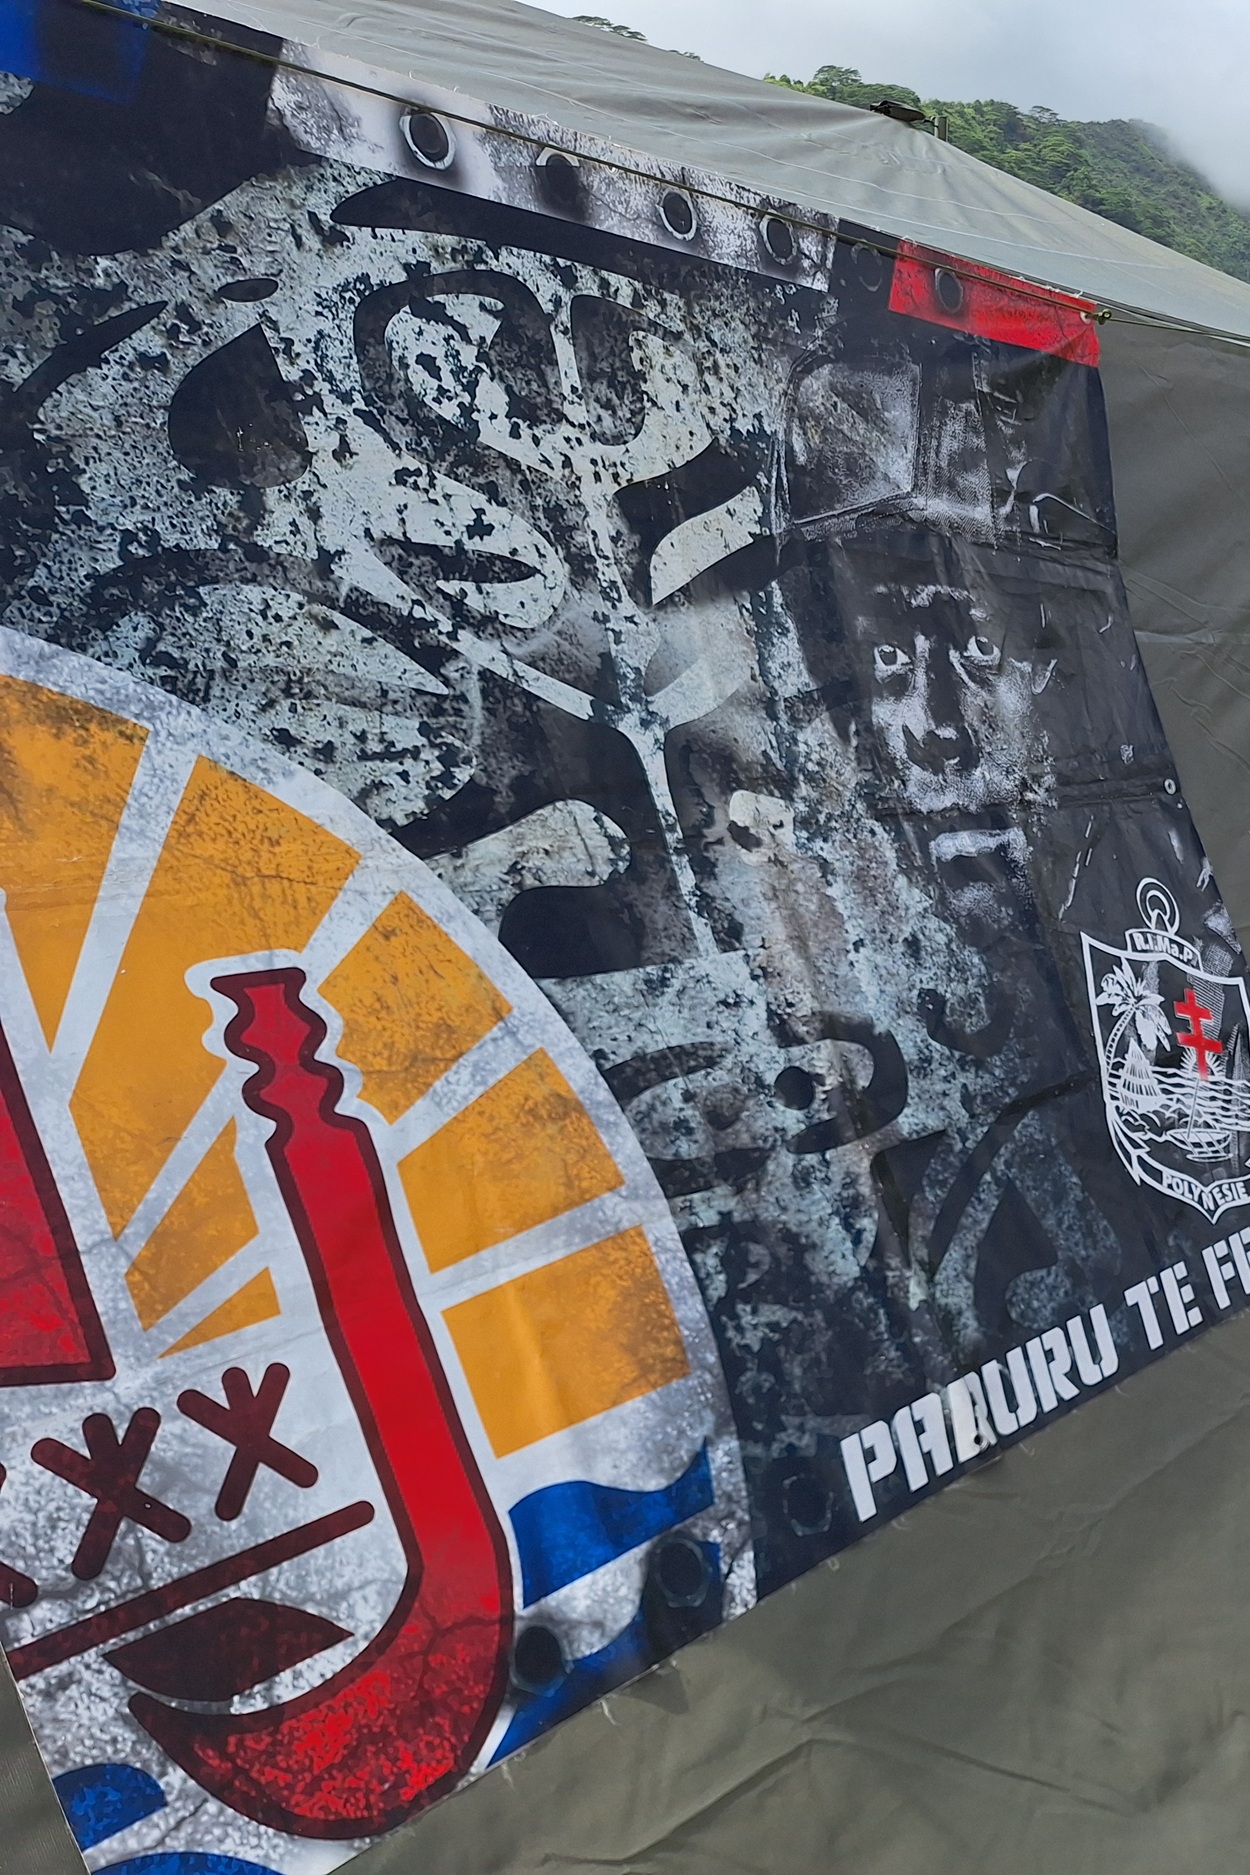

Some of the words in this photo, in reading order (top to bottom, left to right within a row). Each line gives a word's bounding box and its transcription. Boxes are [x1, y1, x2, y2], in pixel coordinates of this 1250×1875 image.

[1162, 1171, 1249, 1211] POLYNESIE
[840, 1303, 1119, 1522] PARURU
[1124, 1261, 1203, 1350] TE
